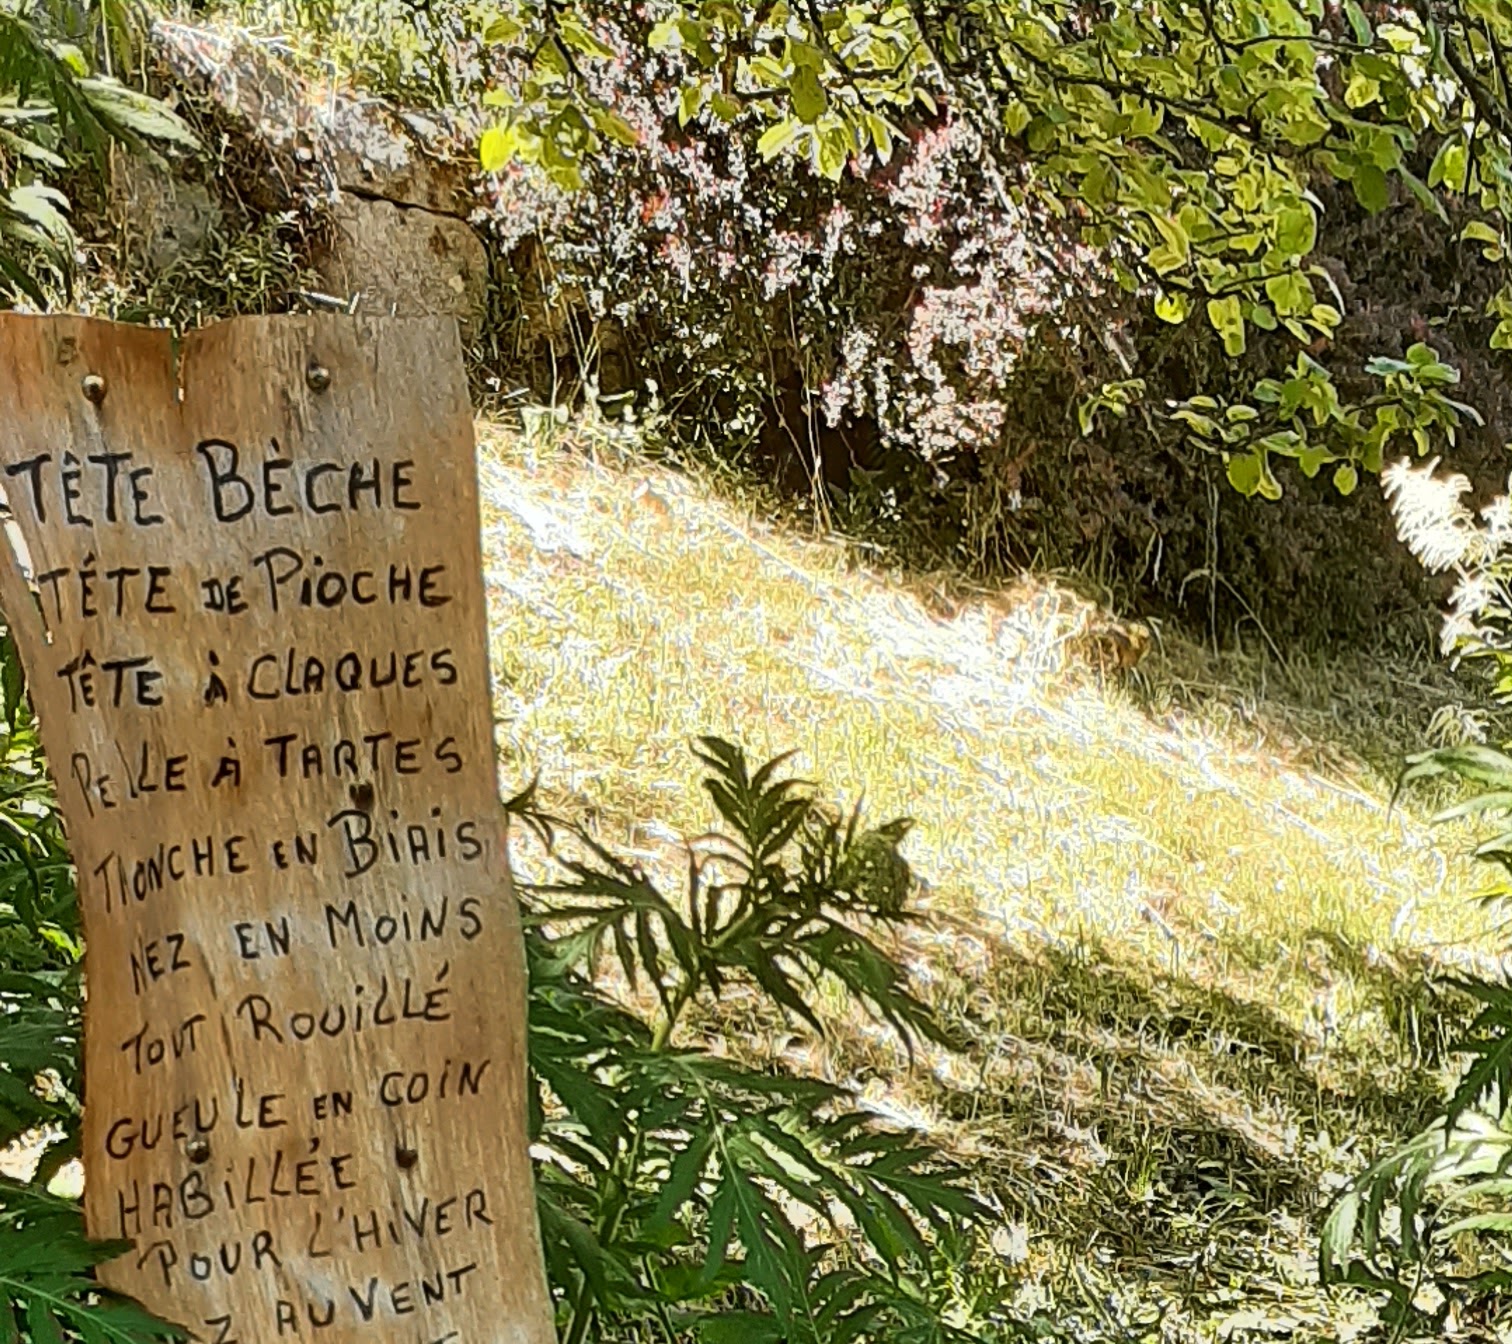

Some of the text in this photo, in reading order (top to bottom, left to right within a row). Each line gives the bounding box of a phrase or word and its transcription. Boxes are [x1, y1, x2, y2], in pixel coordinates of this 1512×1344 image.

[202, 575, 248, 615] DE
[248, 647, 457, 701] CLAQUES
[265, 733, 463, 777] TARTES
[274, 833, 318, 870] EN
[327, 807, 484, 879] BIAIS
[131, 894, 484, 996] NEZ EN MOINS
[122, 1013, 206, 1075] TOUT
[106, 1058, 491, 1160] GUEULE EN COIN
[137, 1229, 283, 1287] POUR
[276, 1263, 477, 1335] AUVENT
